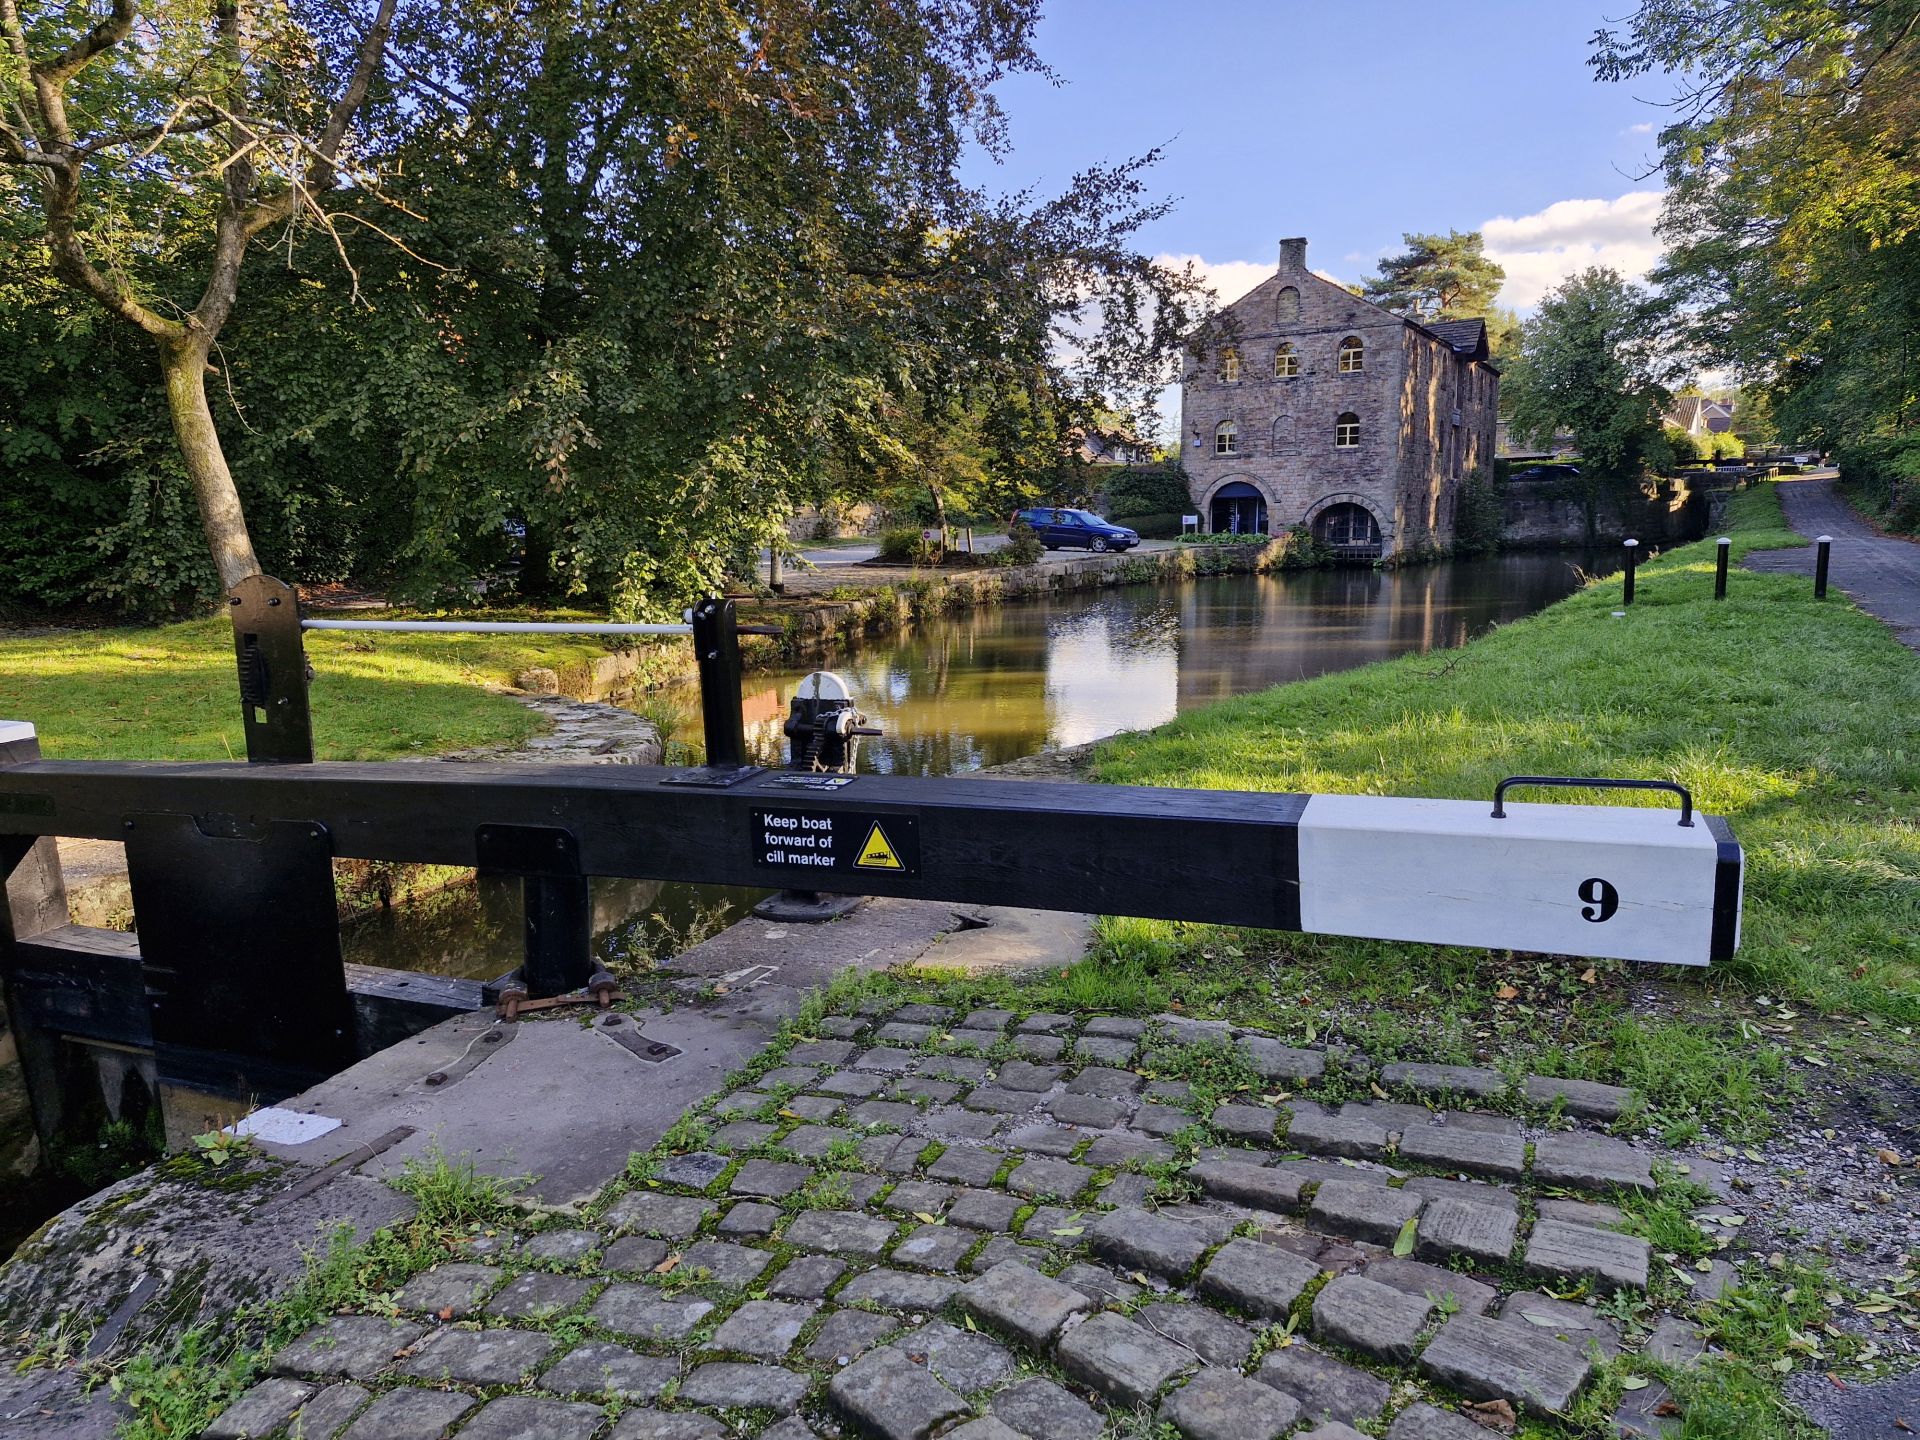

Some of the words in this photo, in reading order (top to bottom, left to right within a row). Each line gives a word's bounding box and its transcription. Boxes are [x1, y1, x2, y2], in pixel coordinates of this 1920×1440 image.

[763, 813, 798, 831] Keep
[801, 815, 833, 830] boat
[764, 831, 815, 848] forward
[818, 835, 833, 849] of
[766, 850, 785, 863] cill
[788, 852, 836, 867] marker
[1577, 877, 1619, 923] 9
